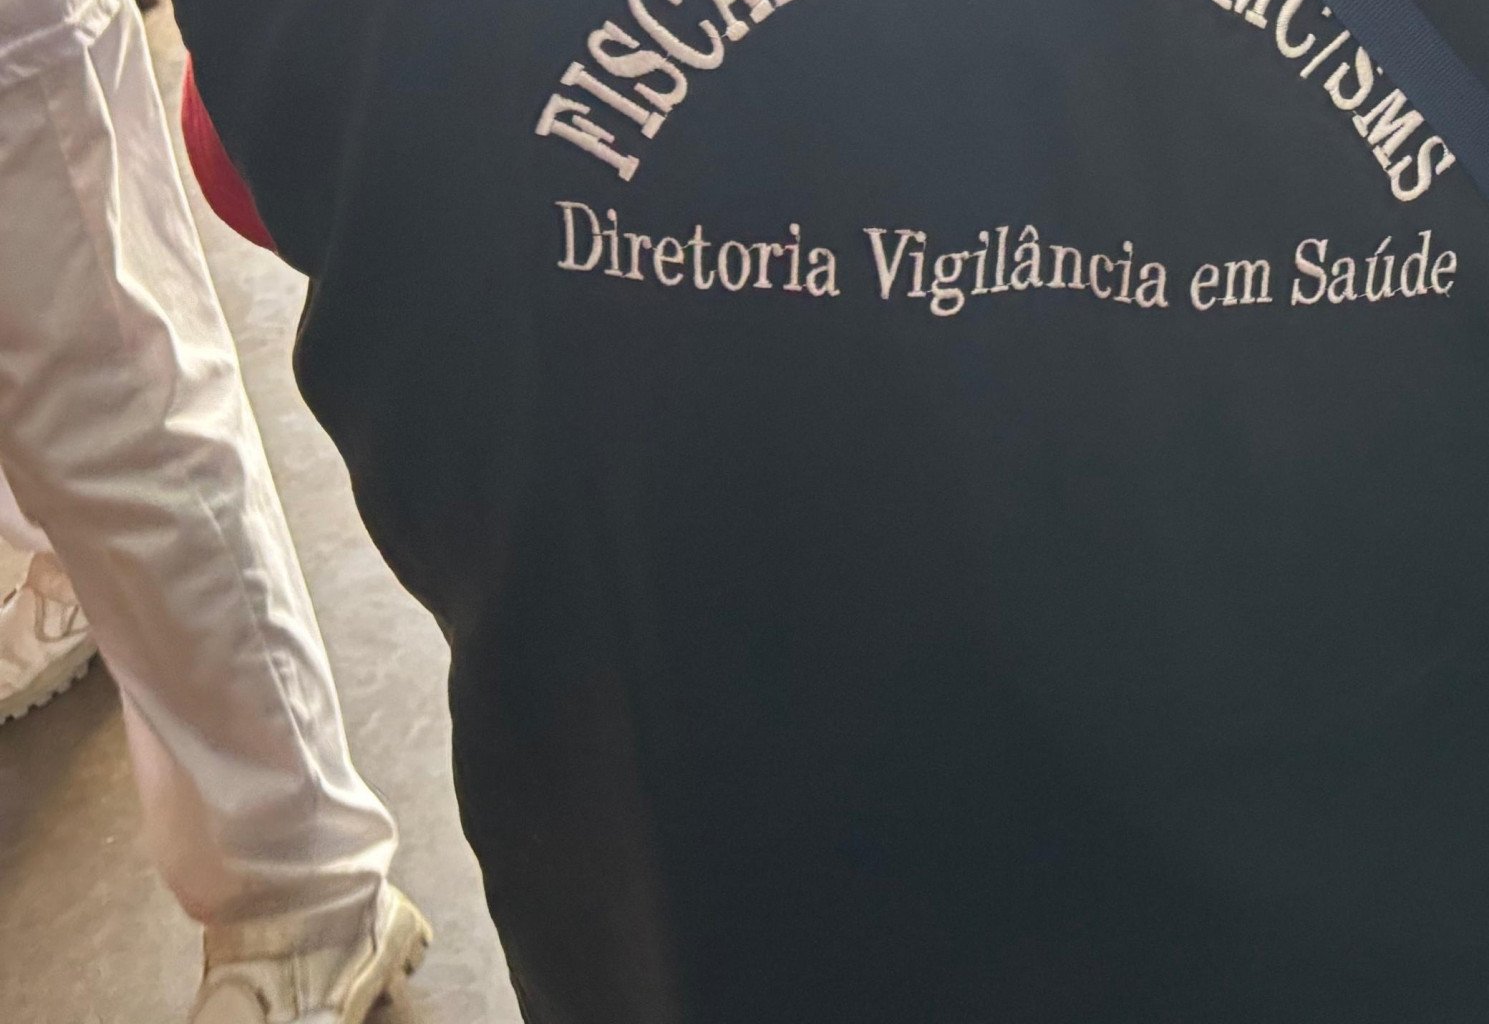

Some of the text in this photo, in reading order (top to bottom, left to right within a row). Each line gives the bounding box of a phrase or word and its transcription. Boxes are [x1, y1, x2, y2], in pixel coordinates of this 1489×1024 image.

[556, 201, 1458, 317] Diretoria Vigilância em Saúde
